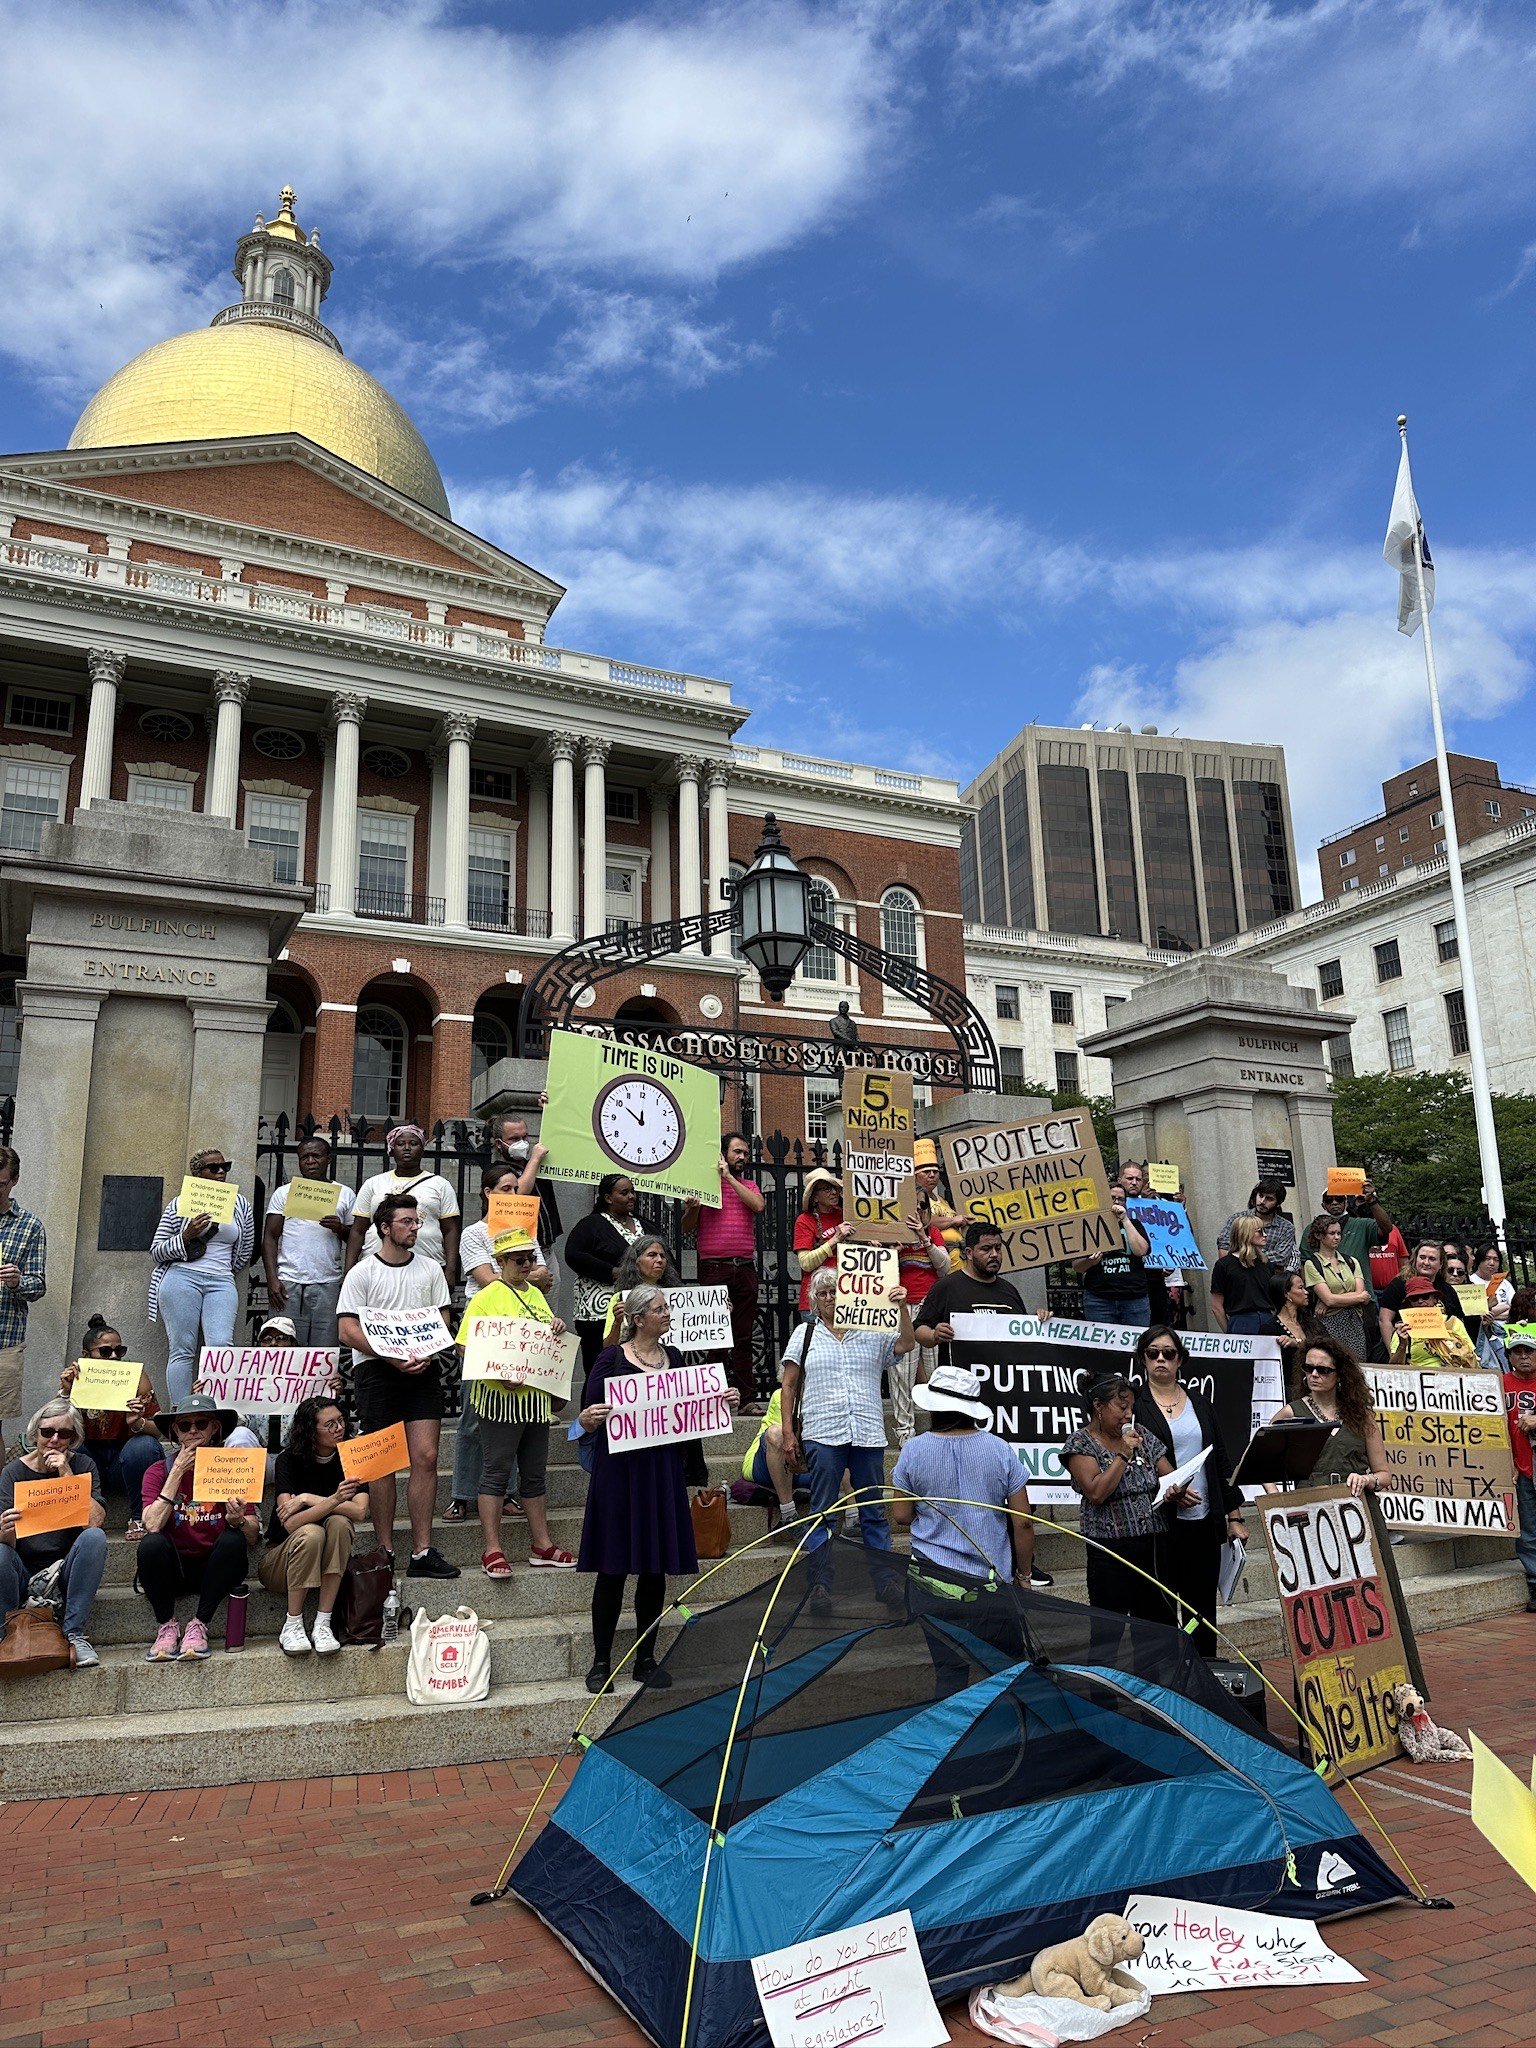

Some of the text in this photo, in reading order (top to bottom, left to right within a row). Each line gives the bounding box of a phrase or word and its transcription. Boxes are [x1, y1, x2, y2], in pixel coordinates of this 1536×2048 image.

[90, 912, 217, 940] BULFINCH
[83, 959, 218, 987] ENTRANCE
[1238, 1036, 1299, 1053] BULFINCH
[601, 1044, 684, 1083] TIME IS UP!
[805, 1050, 874, 1069] STATE
[883, 1052, 960, 1077] HOUSE
[1240, 1069, 1304, 1086] ENTRANCE
[615, 1099, 623, 1108] 10
[639, 1091, 646, 1100] 12
[862, 1074, 892, 1112] 5
[848, 1107, 908, 1131] Nights
[858, 1133, 896, 1151] then
[951, 1117, 1083, 1171] PROTECT
[846, 1141, 912, 1174] homeless
[539, 1164, 574, 1177] FAMILIES
[574, 1168, 590, 1179] ARE
[640, 1180, 654, 1189] OUT
[655, 1182, 672, 1191] WITH
[672, 1185, 703, 1199] NOWHERE
[703, 1191, 711, 1200] TO
[711, 1194, 719, 1204] GO
[854, 1174, 903, 1198] NOT
[960, 1155, 1088, 1197] OUR FAMILY
[855, 1199, 900, 1222] OK
[969, 1185, 1091, 1226] Shelter
[1127, 1204, 1185, 1236] ousing
[1000, 1215, 1116, 1267] YSTEM
[841, 1247, 892, 1273] STOP
[1101, 1257, 1131, 1266] Homes
[1103, 1264, 1131, 1274] for All
[838, 1273, 885, 1296] CUTS
[669, 1289, 729, 1309] FOR WAR
[853, 1296, 867, 1307] to
[364, 1320, 444, 1337] KIDS DESERVE
[835, 1305, 899, 1328] SHELTERS
[380, 1334, 434, 1346] THAT TOO
[474, 1319, 531, 1339] Right to
[681, 1328, 726, 1344] HOMES
[1008, 1319, 1045, 1337] GOV.
[1048, 1322, 1116, 1345] HEALEY:
[1223, 1338, 1253, 1354] CUTS!
[87, 1366, 117, 1377] Housing
[203, 1349, 337, 1377] NO FAMILIES
[84, 1376, 130, 1387] human right!
[233, 1376, 268, 1402] THE
[608, 1365, 721, 1407] NO FAMILIES
[1419, 1372, 1498, 1412] Families
[609, 1394, 731, 1441] ON THE STREETS
[1395, 1415, 1414, 1442] of
[214, 1455, 249, 1463] Governor
[350, 1440, 382, 1455] Housing
[352, 1451, 379, 1465] human
[1418, 1451, 1437, 1468] in
[1447, 1448, 1484, 1470] FL.
[202, 1477, 215, 1485] put
[235, 1466, 254, 1474] don't
[28, 1485, 63, 1498] Housing
[65, 1484, 73, 1492] is
[208, 1487, 249, 1495] the streets!
[1384, 1473, 1501, 1499] ONG IN TX.
[27, 1494, 80, 1509] human right!
[1382, 1493, 1516, 1531] ONG IN MA!
[1270, 1501, 1367, 1593] STOP
[1294, 1581, 1387, 1656] CUTS
[428, 1675, 469, 1690] MEMBER
[1335, 1655, 1357, 1696] to
[1304, 1674, 1400, 1772] Shelte
[1315, 1888, 1342, 1900] OZARK
[1173, 1906, 1246, 1955] Healey
[756, 1959, 793, 1990] How
[805, 1948, 823, 1974] do
[866, 1925, 908, 1957] Sleep
[794, 1967, 864, 2014] at night
